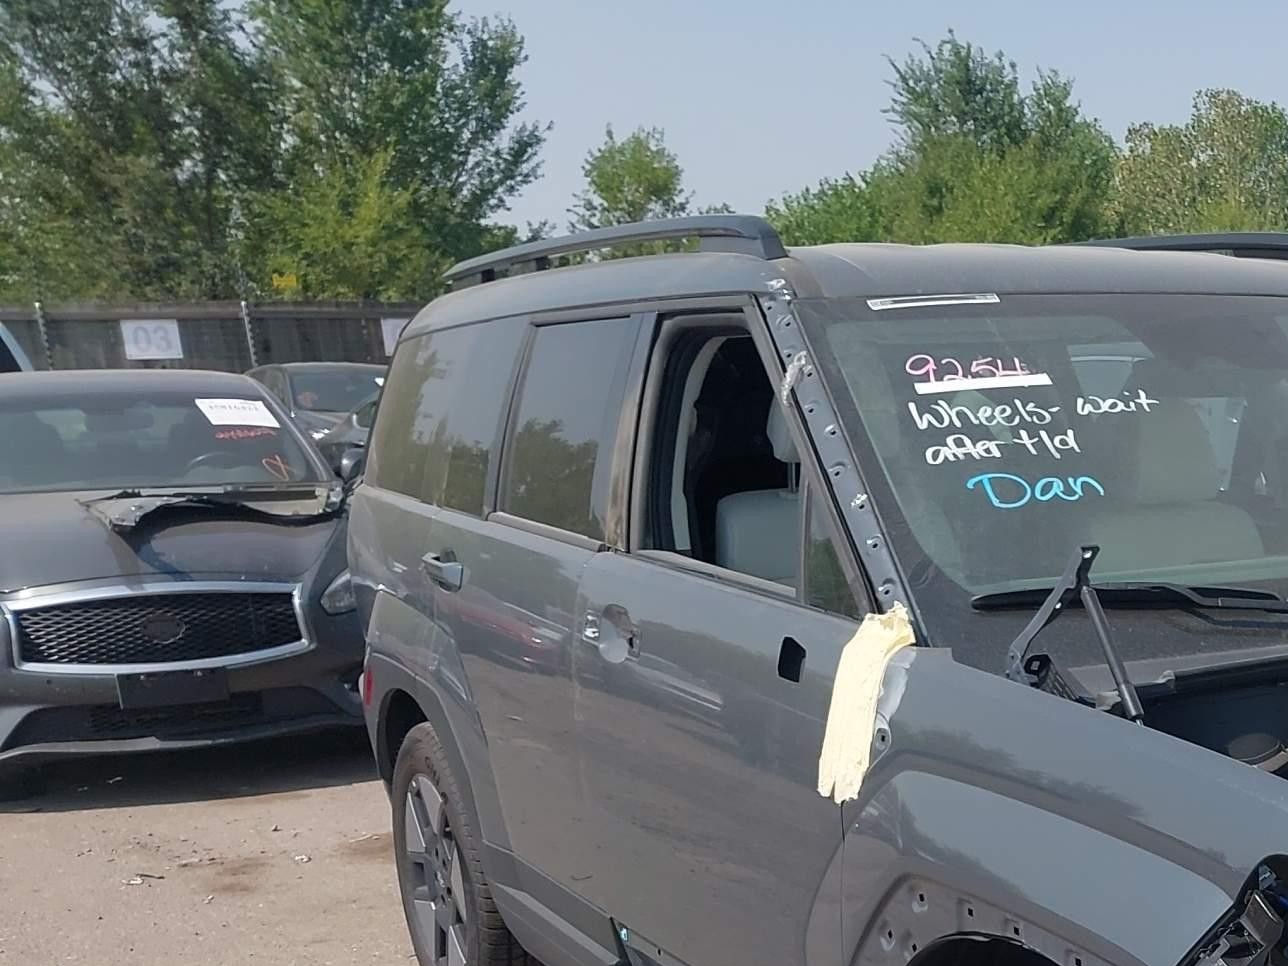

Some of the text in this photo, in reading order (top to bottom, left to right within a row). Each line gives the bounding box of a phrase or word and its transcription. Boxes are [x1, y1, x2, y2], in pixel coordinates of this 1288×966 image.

[132, 326, 173, 353] 03
[925, 433, 1011, 465] after
[965, 472, 1105, 509] Dan
